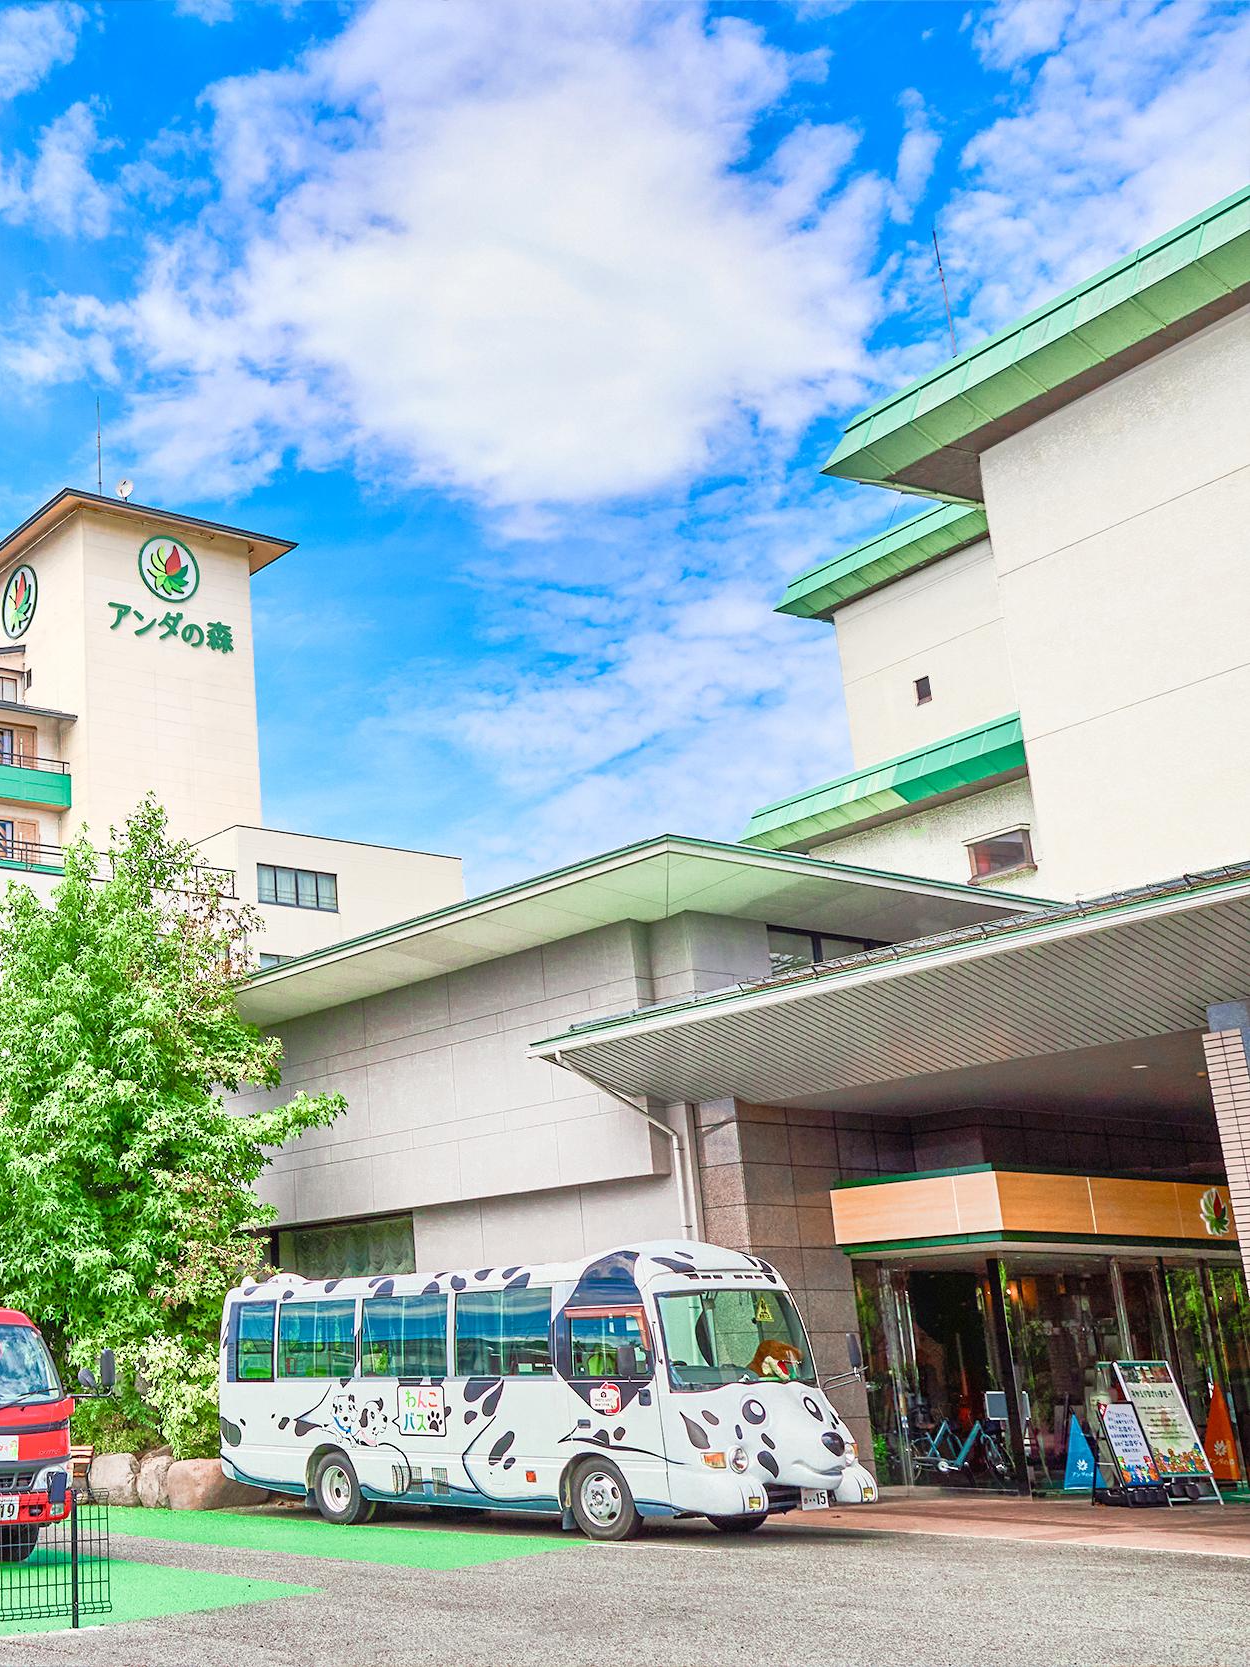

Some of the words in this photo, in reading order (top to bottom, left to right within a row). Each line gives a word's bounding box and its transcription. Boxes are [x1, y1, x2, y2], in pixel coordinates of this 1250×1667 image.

[108, 601, 234, 654] アンダの森
[405, 1390, 438, 1408] わんこ
[403, 1412, 427, 1431] バス
